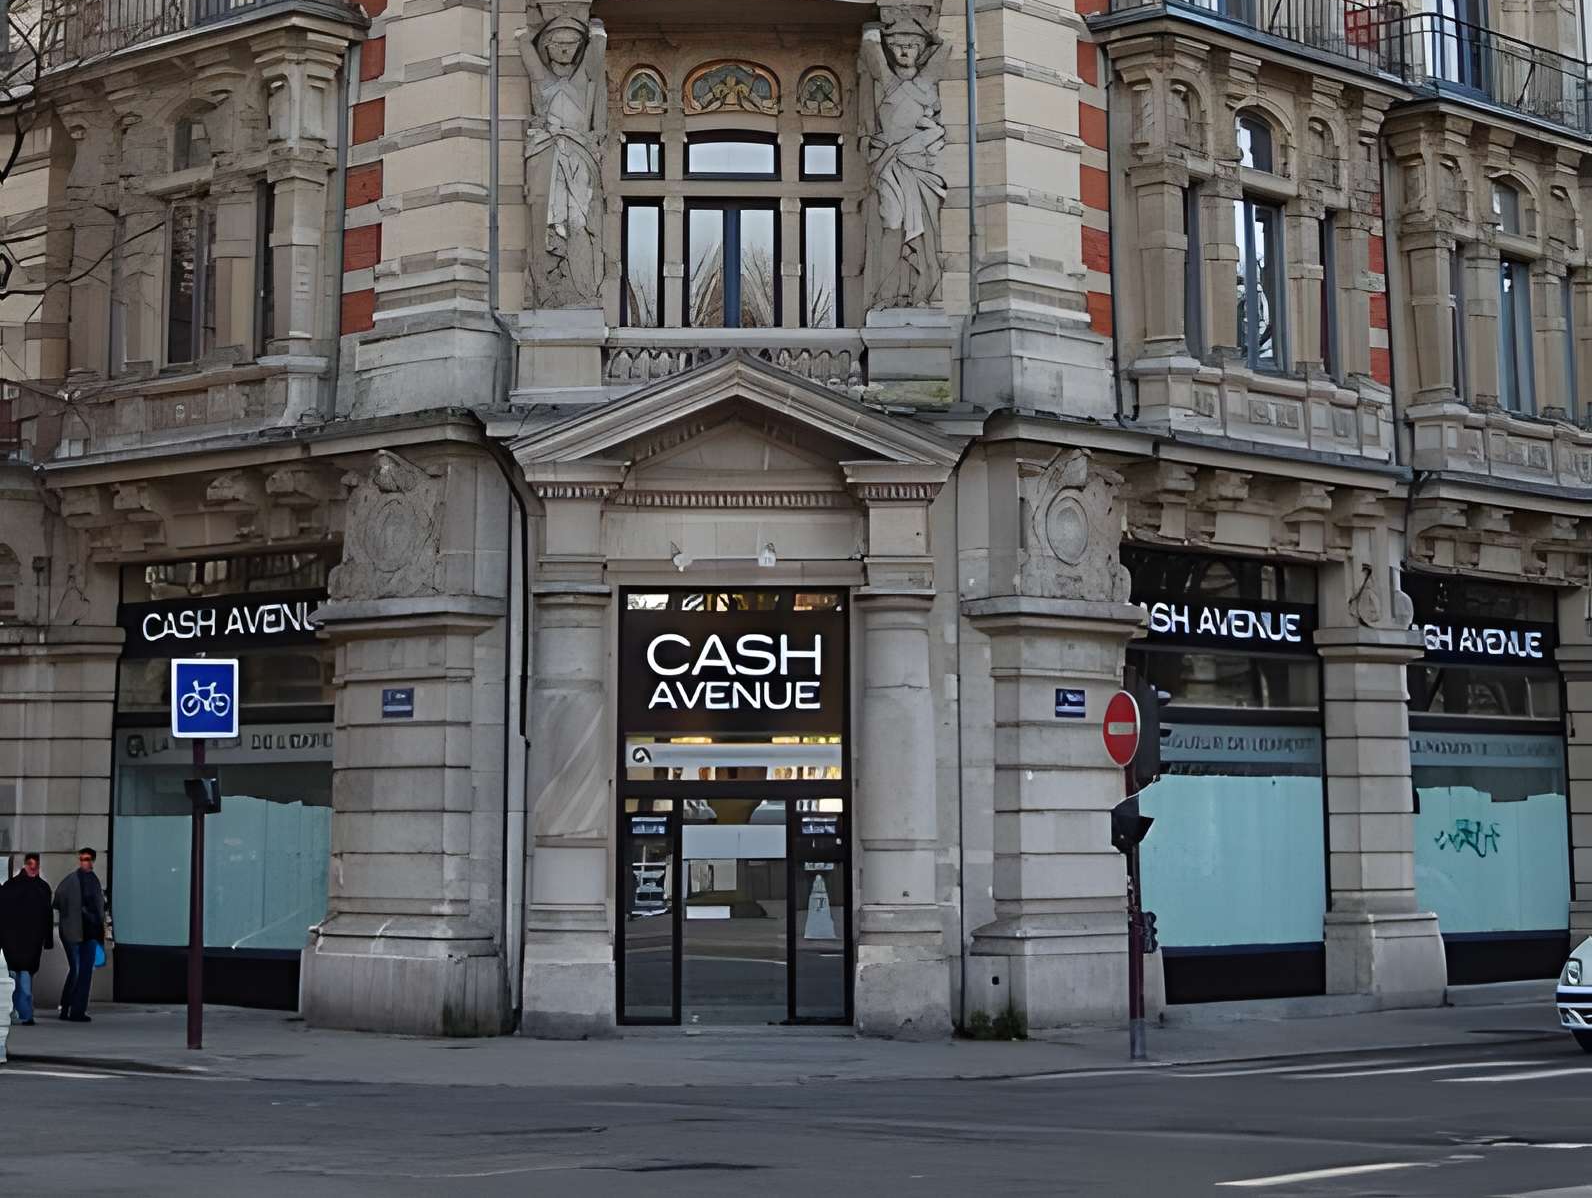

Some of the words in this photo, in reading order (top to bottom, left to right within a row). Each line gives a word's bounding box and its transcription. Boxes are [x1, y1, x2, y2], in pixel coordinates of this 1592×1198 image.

[142, 609, 216, 641] CASH
[224, 602, 316, 634] AVENU
[1140, 602, 1190, 633] SH
[1197, 606, 1302, 642] AVENUE
[646, 633, 822, 676] CASH
[648, 681, 821, 710] AVENUE
